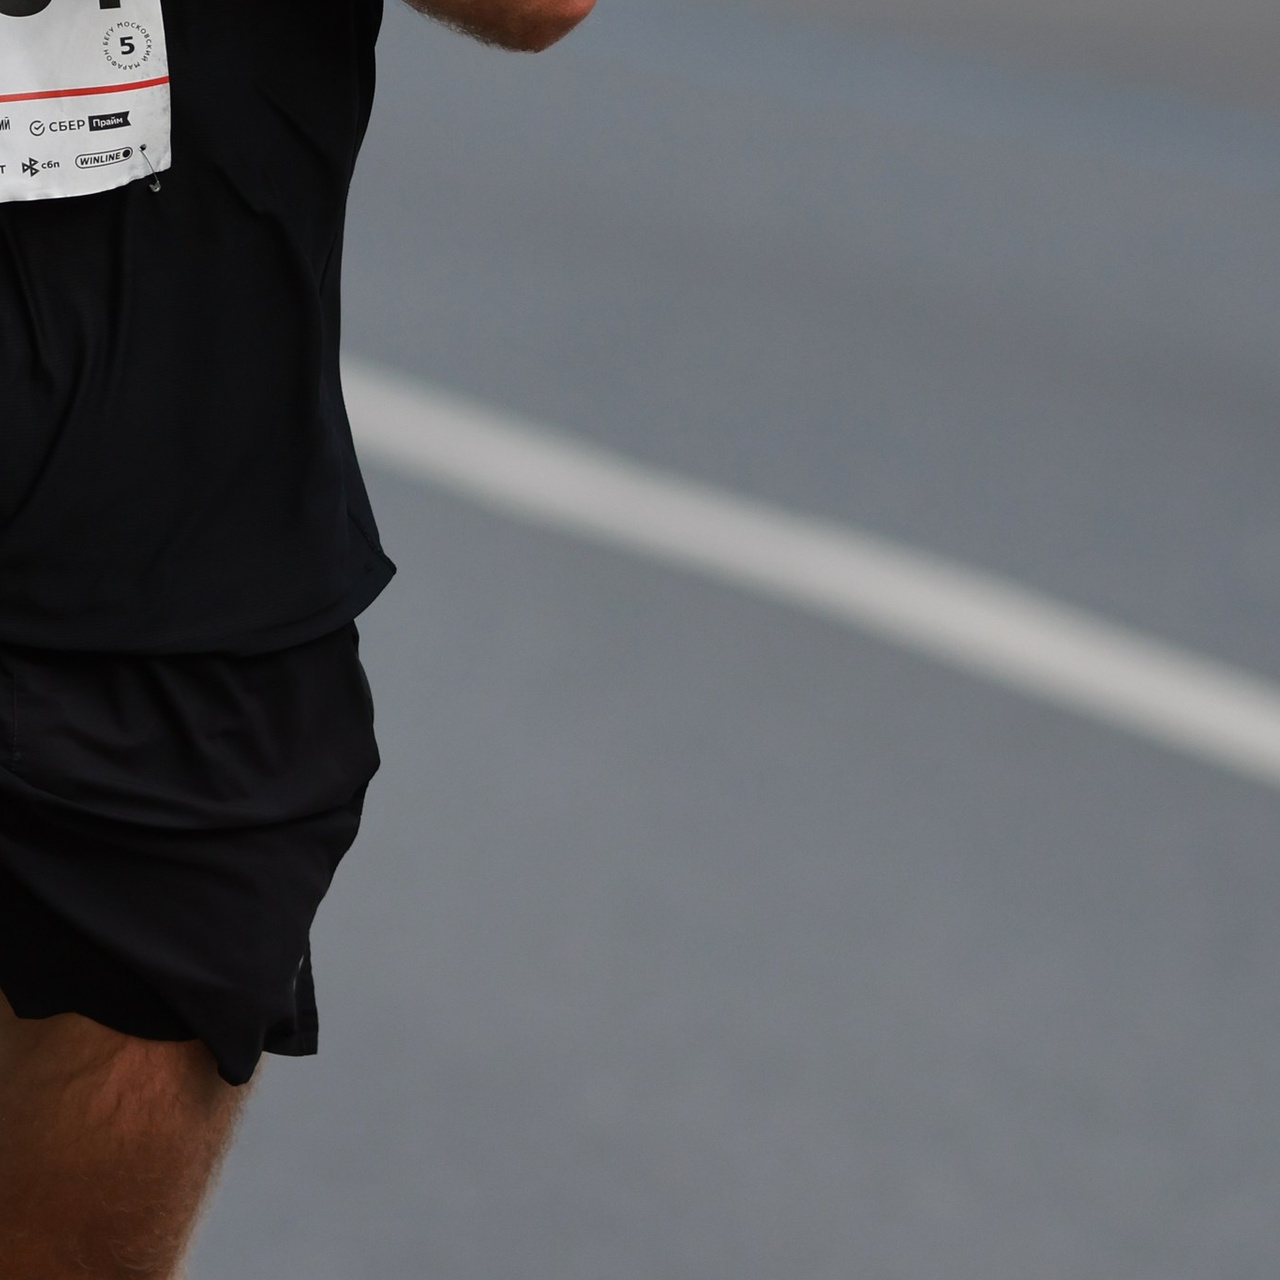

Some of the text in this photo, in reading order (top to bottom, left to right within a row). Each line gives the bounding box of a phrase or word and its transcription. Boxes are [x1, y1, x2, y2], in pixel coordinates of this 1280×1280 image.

[119, 36, 135, 55] 5
[49, 116, 123, 132] СБЕР Прайм
[80, 152, 121, 166] WINLINE
